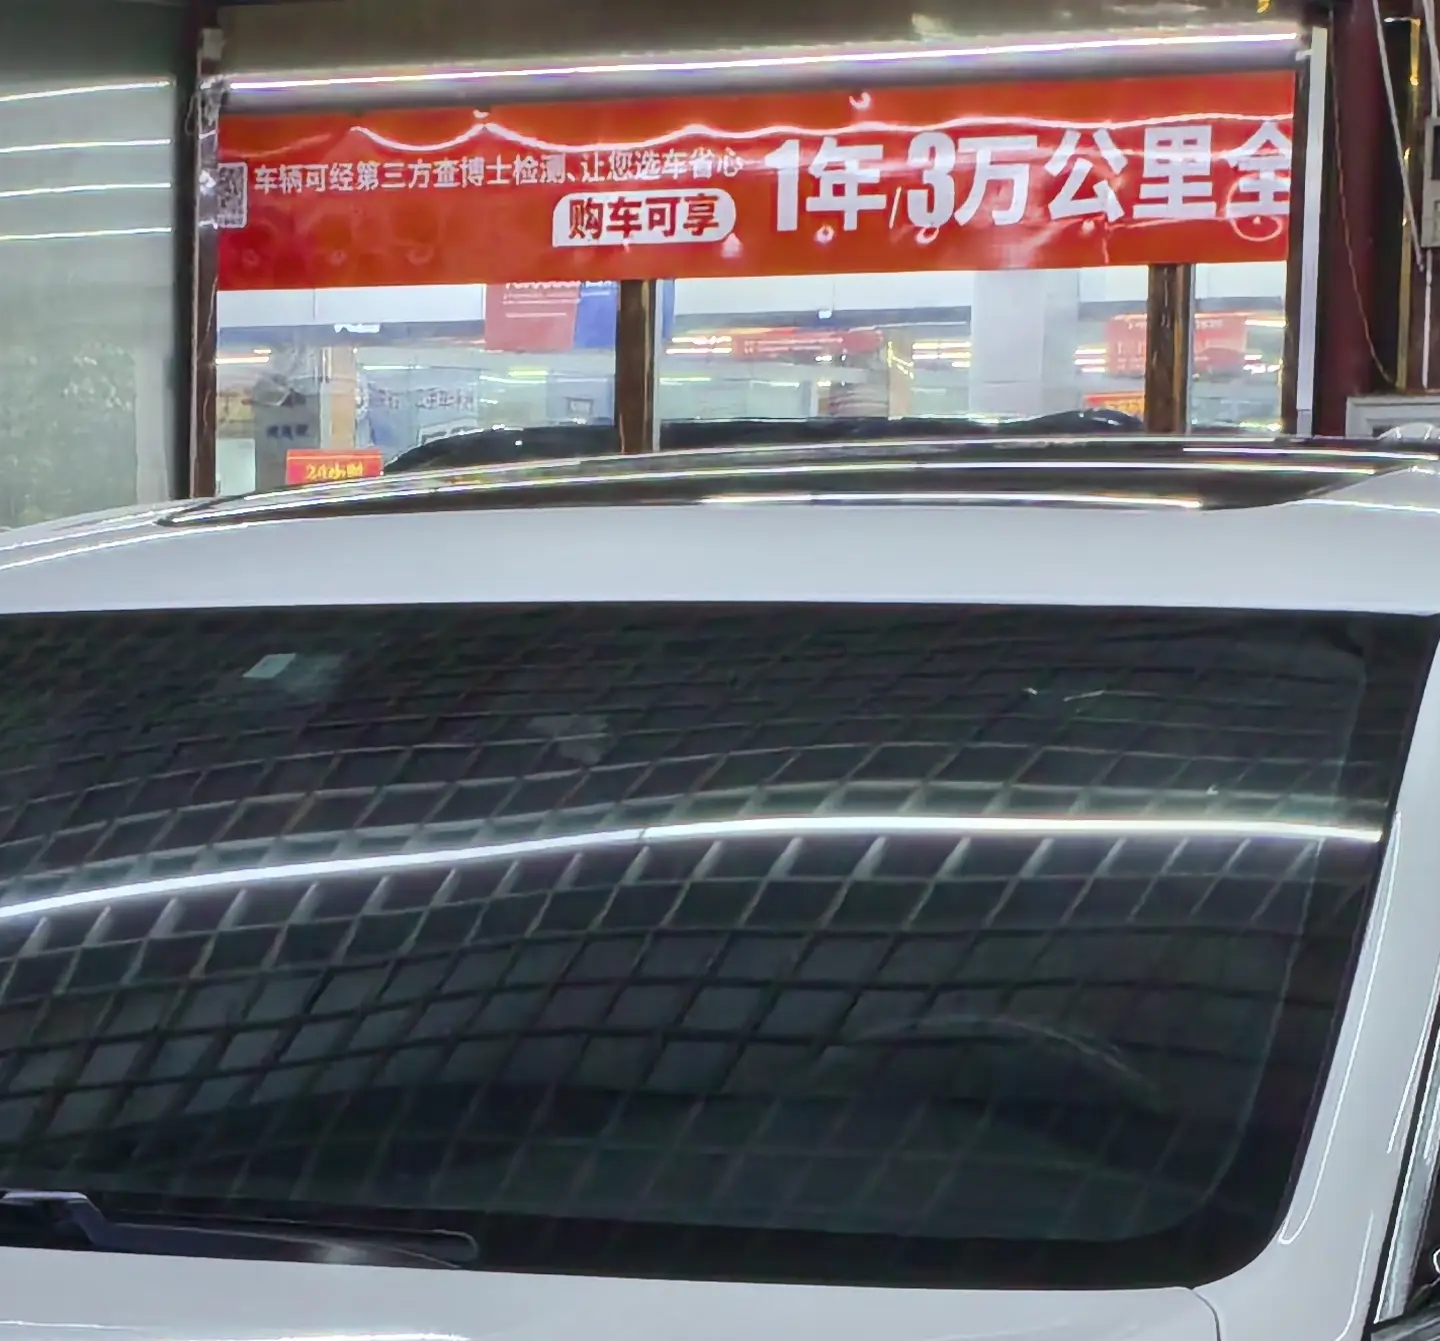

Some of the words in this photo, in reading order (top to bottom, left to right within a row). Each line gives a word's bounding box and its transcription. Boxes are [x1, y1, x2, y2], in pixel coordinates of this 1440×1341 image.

[253, 147, 744, 194] 车辆可经第三方查博士检测、让您选车省心
[567, 193, 720, 240] 购车可享
